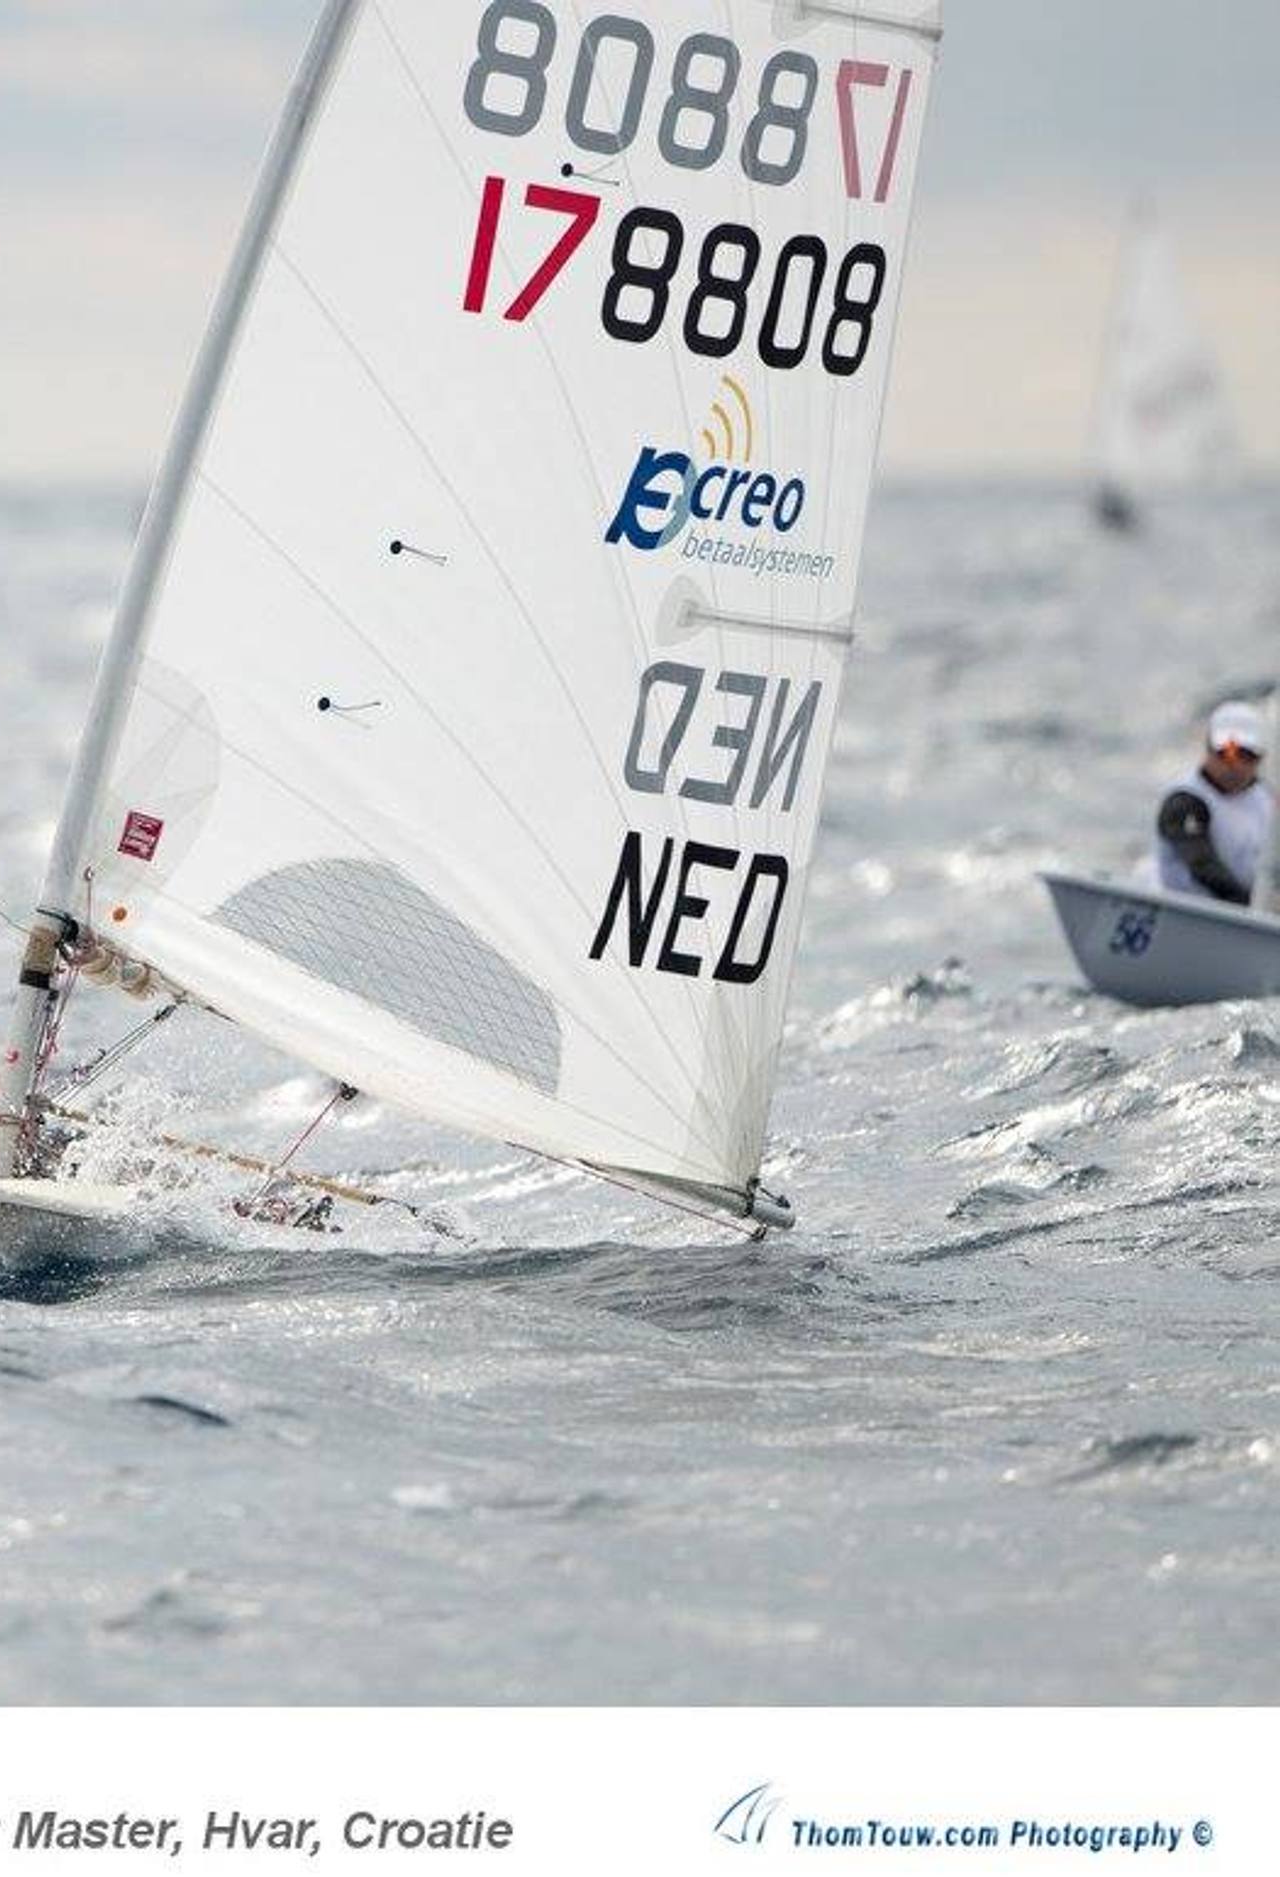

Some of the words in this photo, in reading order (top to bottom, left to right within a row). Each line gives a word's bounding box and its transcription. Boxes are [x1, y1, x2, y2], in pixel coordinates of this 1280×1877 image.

[463, 176, 886, 376] 178808
[682, 533, 835, 577] betaalsystemen
[588, 831, 789, 985] NED
